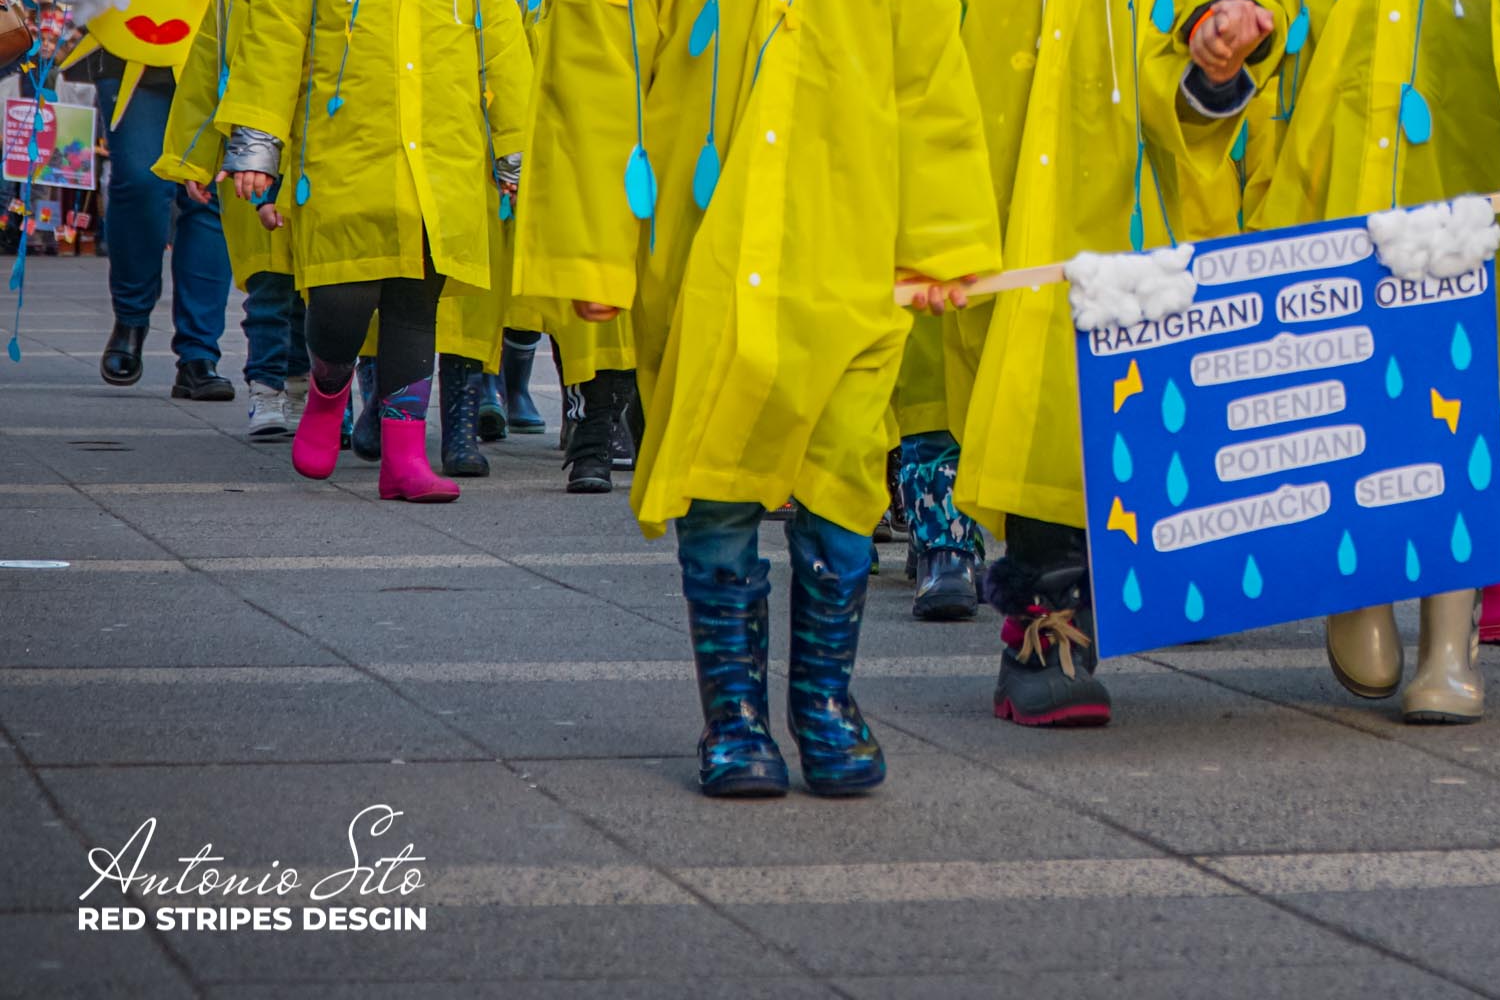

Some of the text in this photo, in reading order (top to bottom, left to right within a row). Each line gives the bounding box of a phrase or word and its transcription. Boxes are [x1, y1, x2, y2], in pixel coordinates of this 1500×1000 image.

[1198, 233, 1371, 281] DV ĐAKOVO
[1094, 266, 1485, 354] RAZIGRANI KIŠNI OBLACI
[1194, 332, 1370, 381] PREDŠKOLE
[1229, 385, 1342, 429] DRENJE
[1219, 429, 1362, 477] POTNJANI
[1155, 468, 1443, 548] ĐAKOVAČKI SELCI
